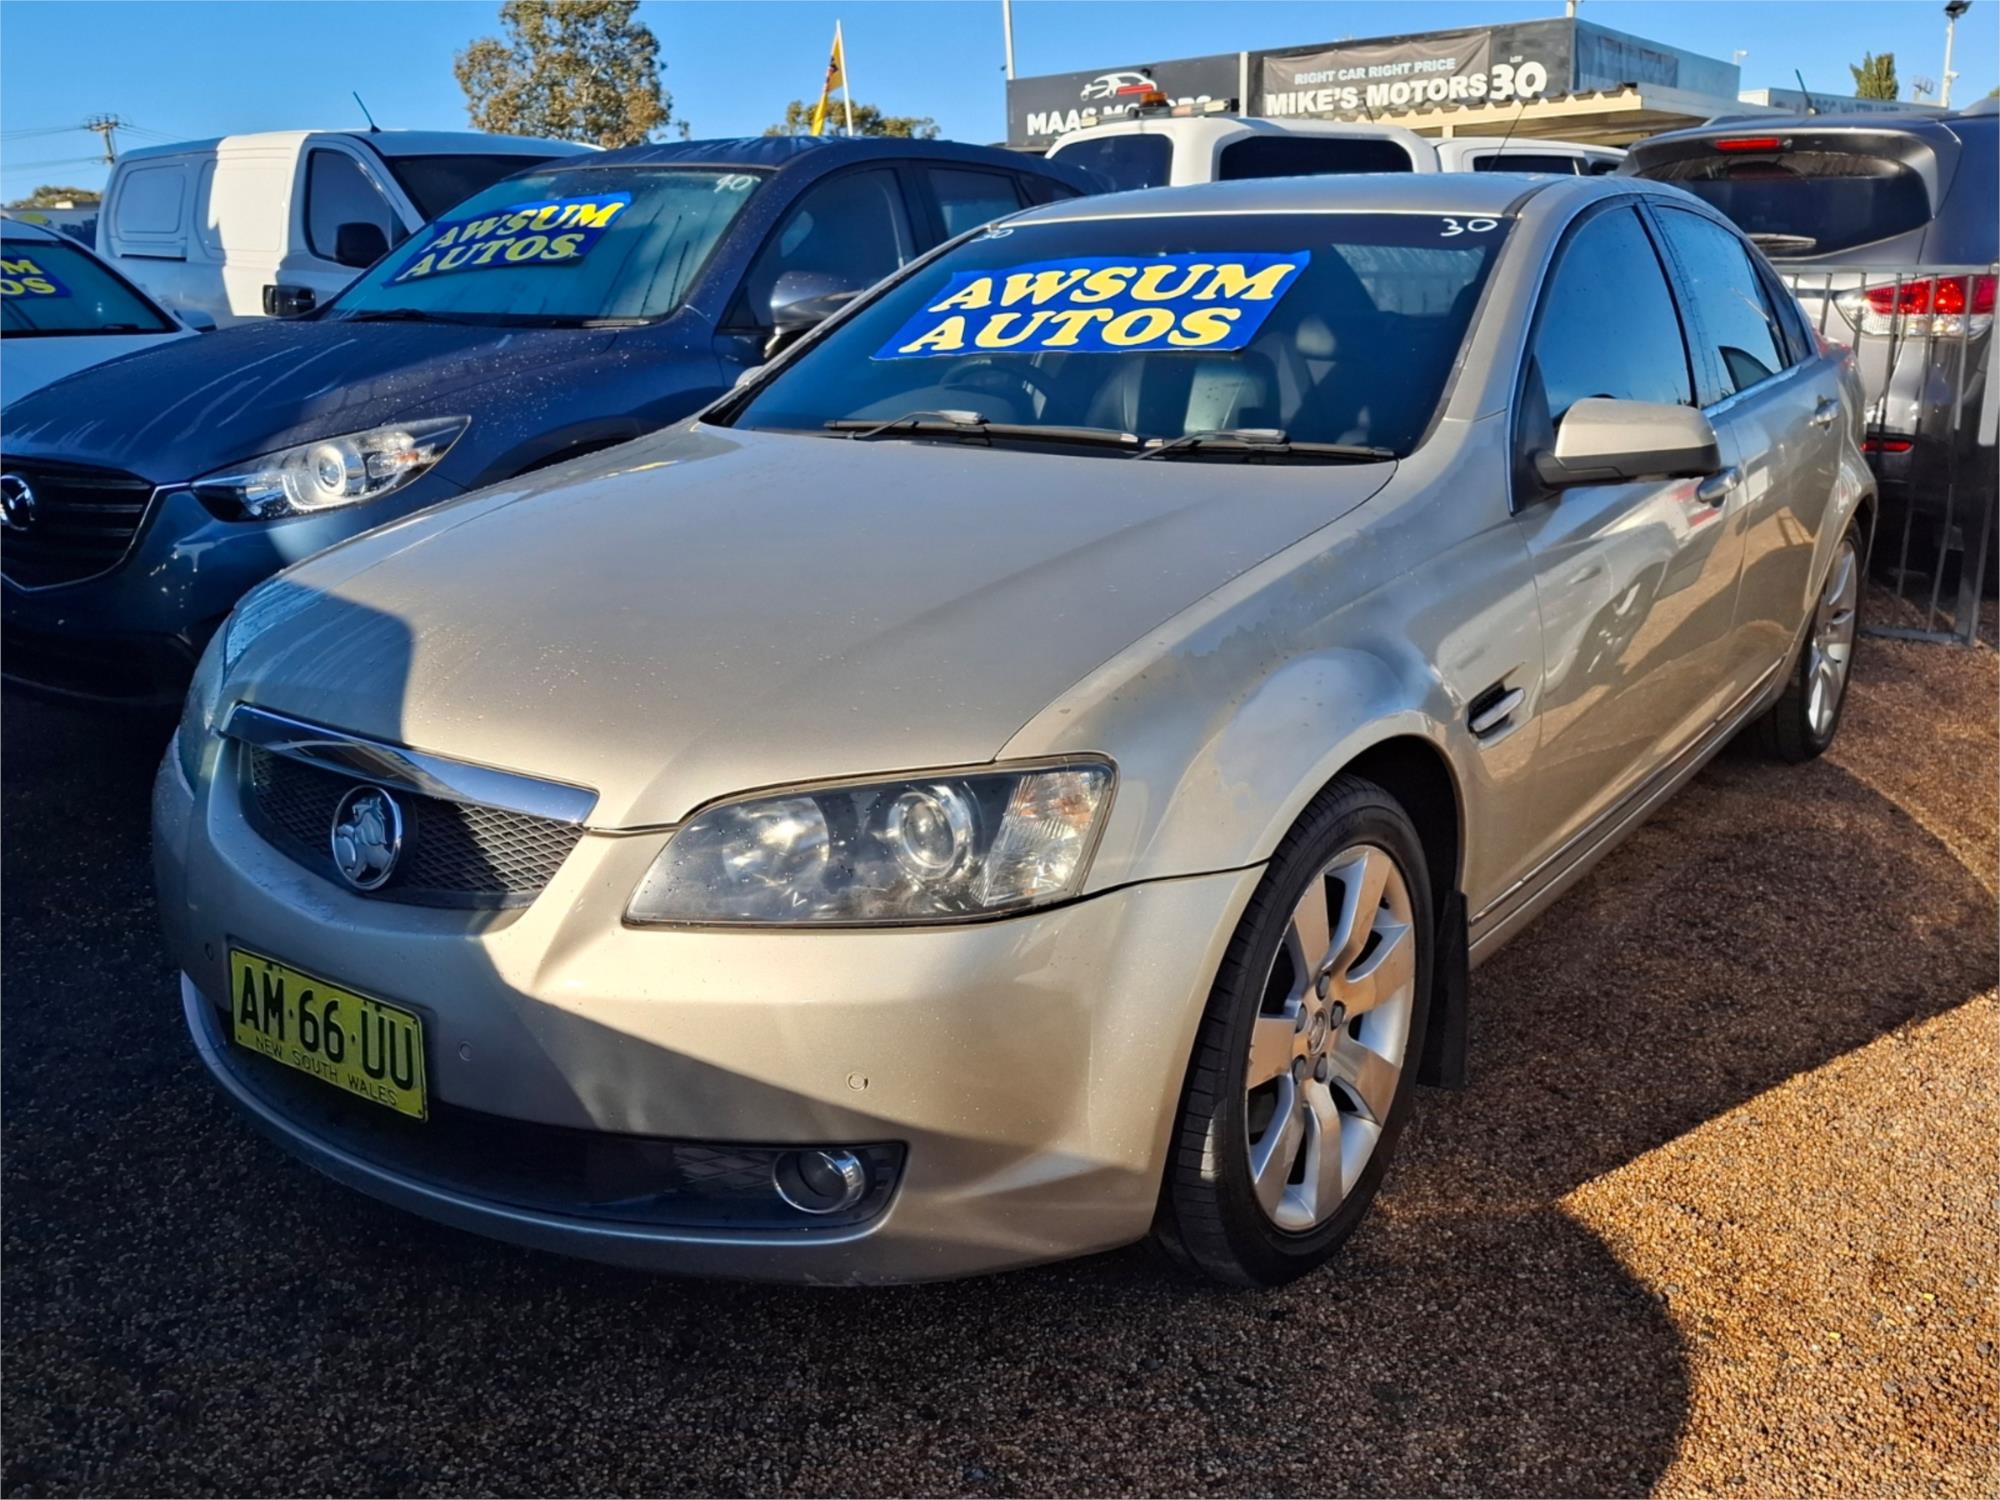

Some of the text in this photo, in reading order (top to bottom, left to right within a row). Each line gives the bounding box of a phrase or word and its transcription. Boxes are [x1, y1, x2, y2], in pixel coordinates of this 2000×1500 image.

[1265, 73, 1488, 116] MIKE'S MOTORS
[1294, 58, 1456, 85] RIGHT CAR RIGHT PRICE
[1490, 61, 1547, 100] 30
[421, 202, 625, 254] AWSUM
[1440, 218, 1498, 237] 30
[394, 233, 586, 282] AUTOS
[927, 264, 1297, 312] AWSUM
[899, 307, 1242, 353] AUTOS
[255, 1034, 399, 1106] NEW SOUTH WALES
